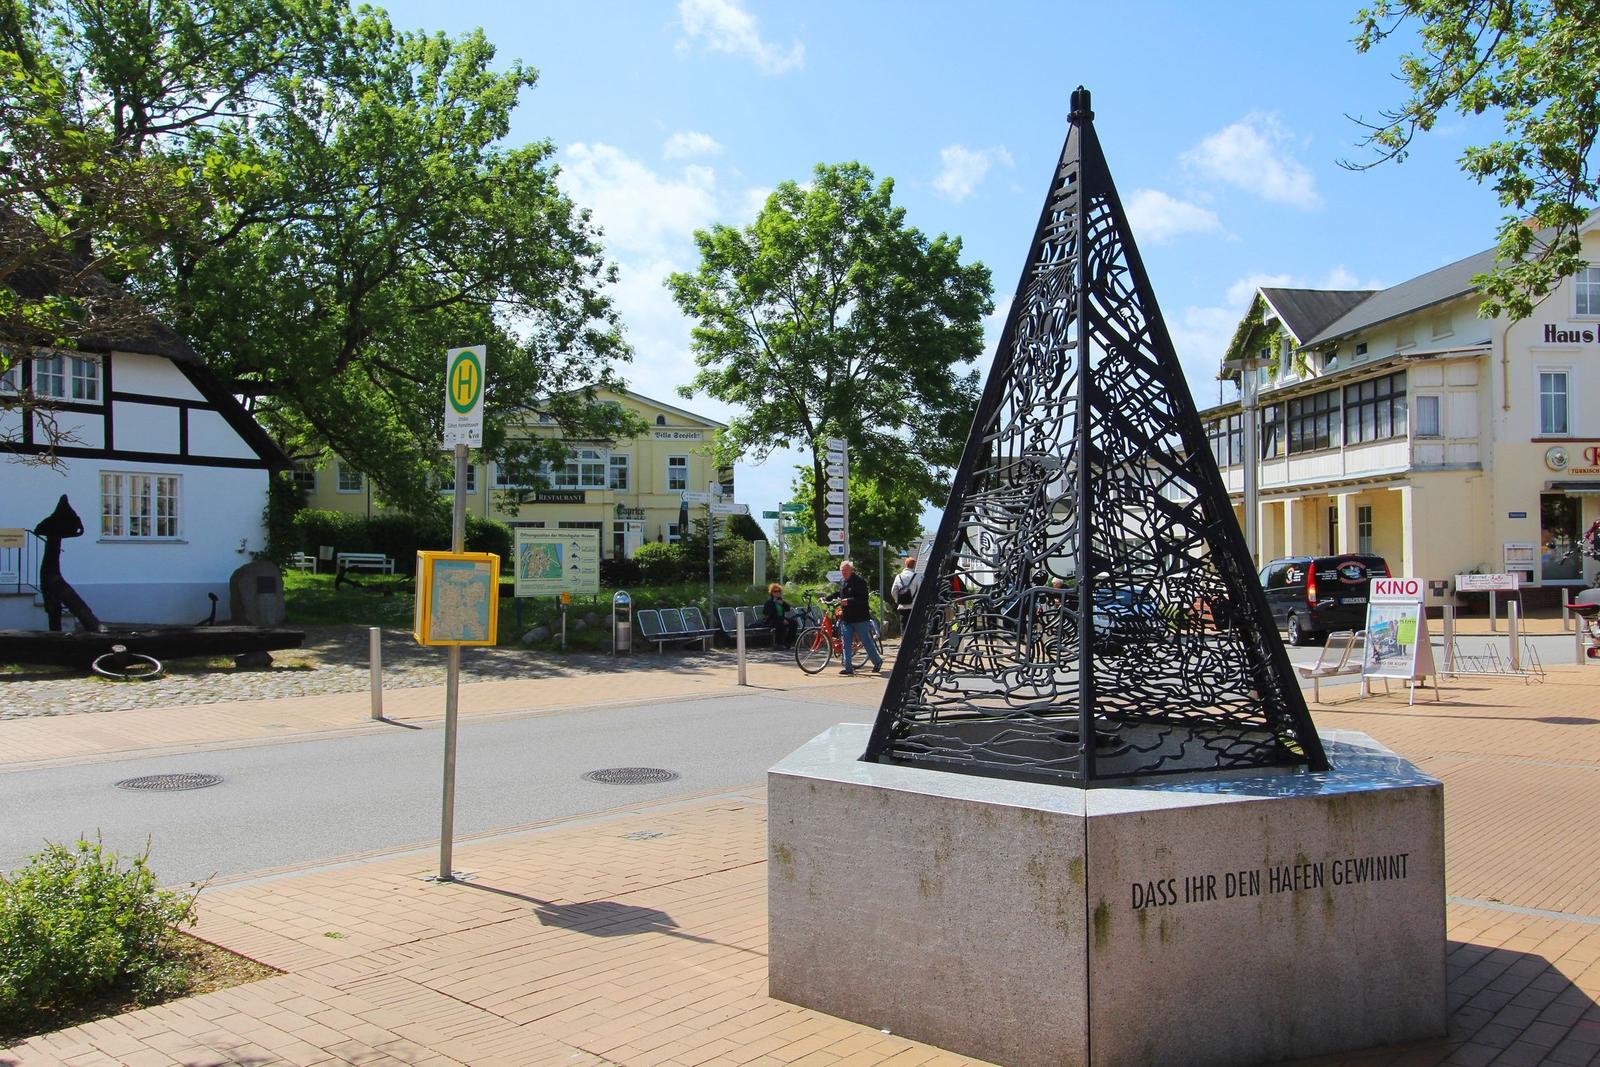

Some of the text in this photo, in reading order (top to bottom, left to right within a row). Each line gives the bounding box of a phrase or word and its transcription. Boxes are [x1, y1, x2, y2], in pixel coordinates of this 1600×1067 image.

[1544, 324, 1594, 343] Haus
[458, 364, 472, 400] H
[1375, 581, 1418, 595] KINO
[1131, 853, 1410, 910] DASS IHR DEN HAFEN GEWINNT
